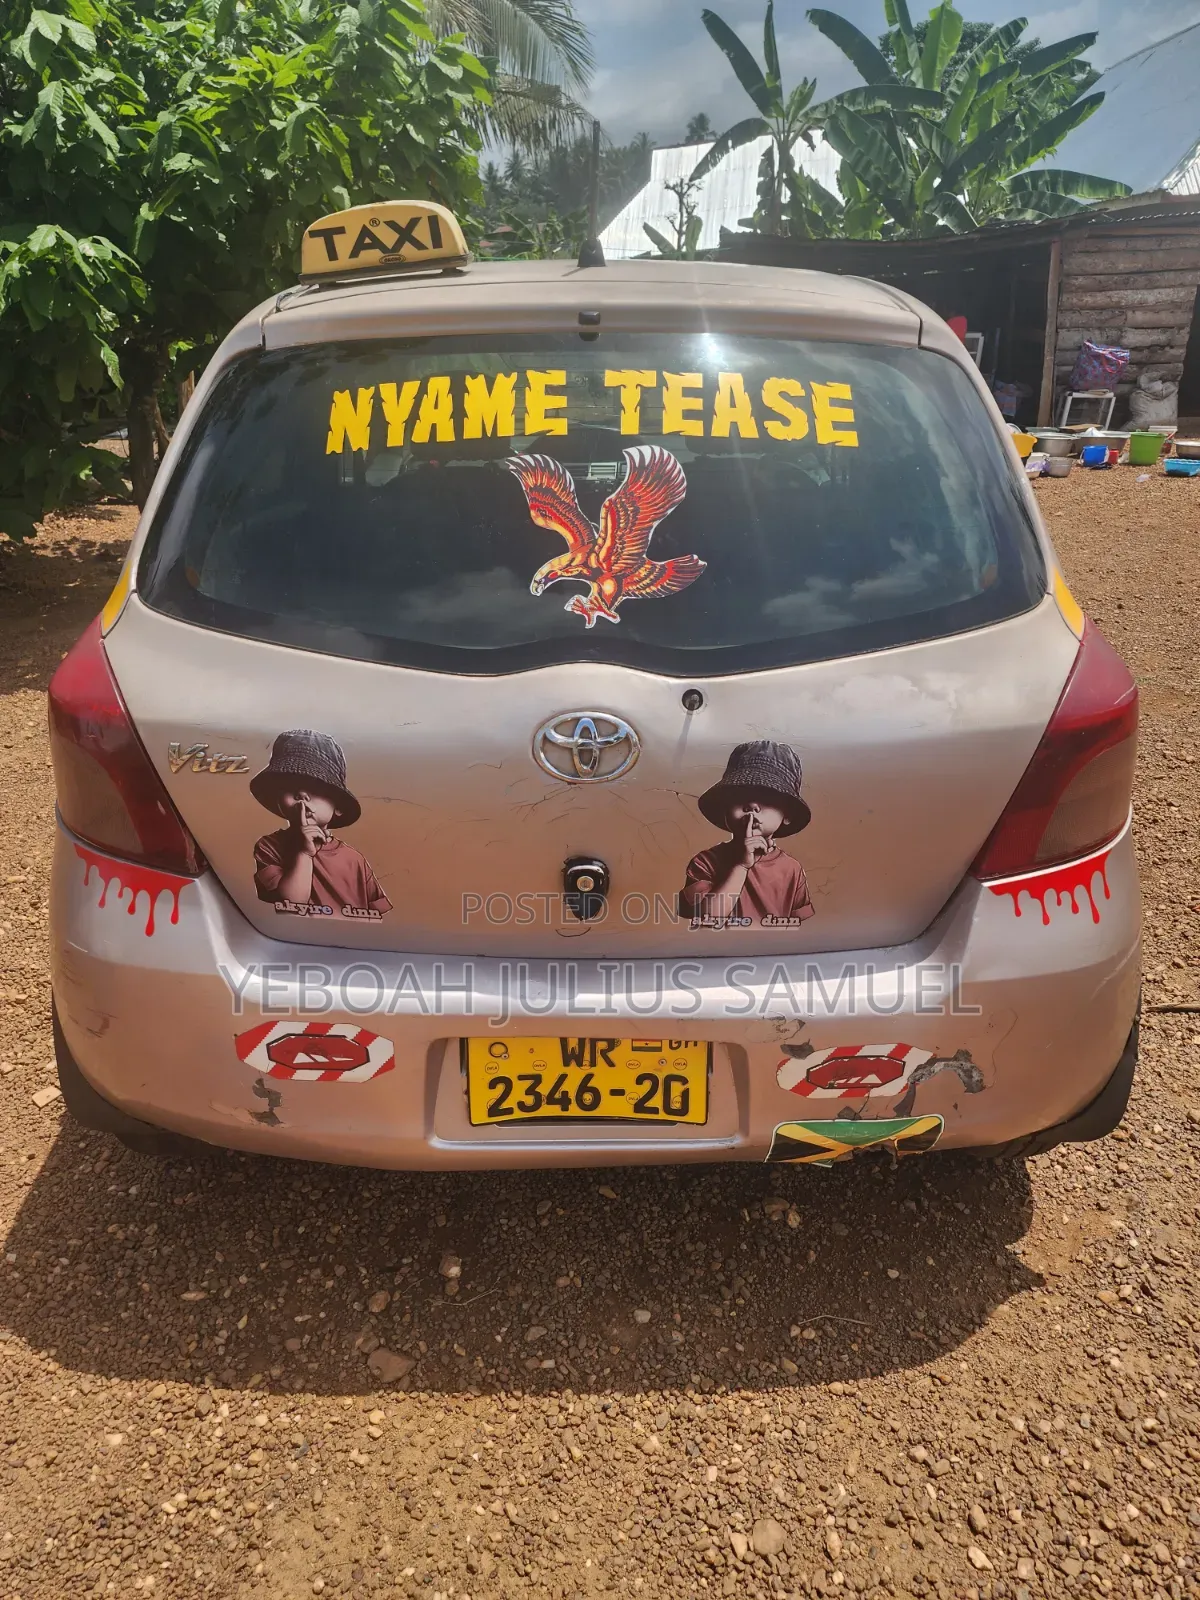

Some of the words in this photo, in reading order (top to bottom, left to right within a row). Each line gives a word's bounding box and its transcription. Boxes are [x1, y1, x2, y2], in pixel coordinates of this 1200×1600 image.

[307, 214, 443, 262] TAXI
[326, 369, 568, 454] NYAME
[604, 369, 859, 447] TEASE
[167, 742, 250, 774] Vitz
[274, 899, 333, 916] akyire
[341, 904, 383, 919] dinn
[761, 914, 801, 928] dinn
[560, 1038, 616, 1067] WR
